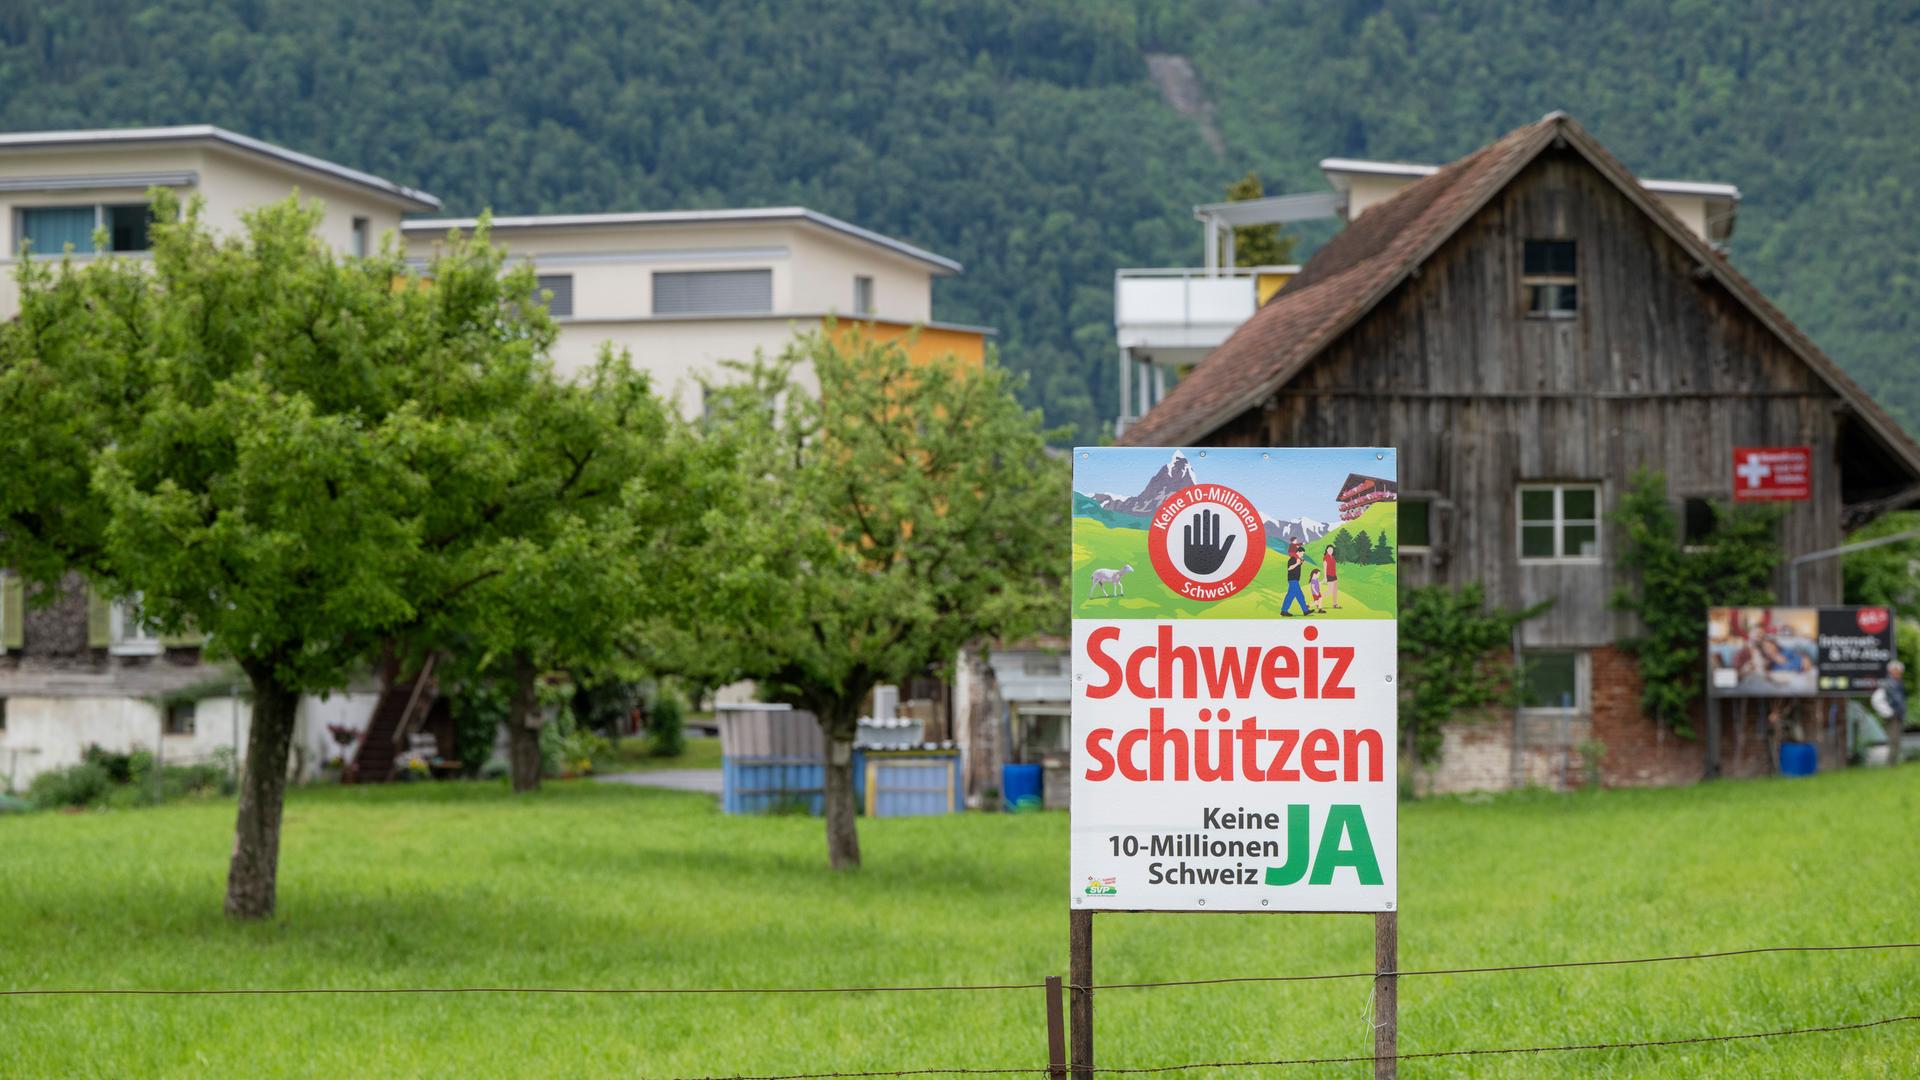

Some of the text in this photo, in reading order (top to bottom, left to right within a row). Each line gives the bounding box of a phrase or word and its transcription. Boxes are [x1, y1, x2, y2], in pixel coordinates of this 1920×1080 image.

[1154, 487, 1259, 532] Keine 10-Millionen
[1181, 580, 1237, 599] Schweiz
[1085, 625, 1355, 699] Schweiz
[1085, 707, 1383, 782] schützen
[1109, 834, 1279, 857] 10-Millionen
[1203, 803, 1384, 886] Keine JA
[1089, 886, 1110, 894] SVP
[1148, 863, 1258, 885] Schweiz
